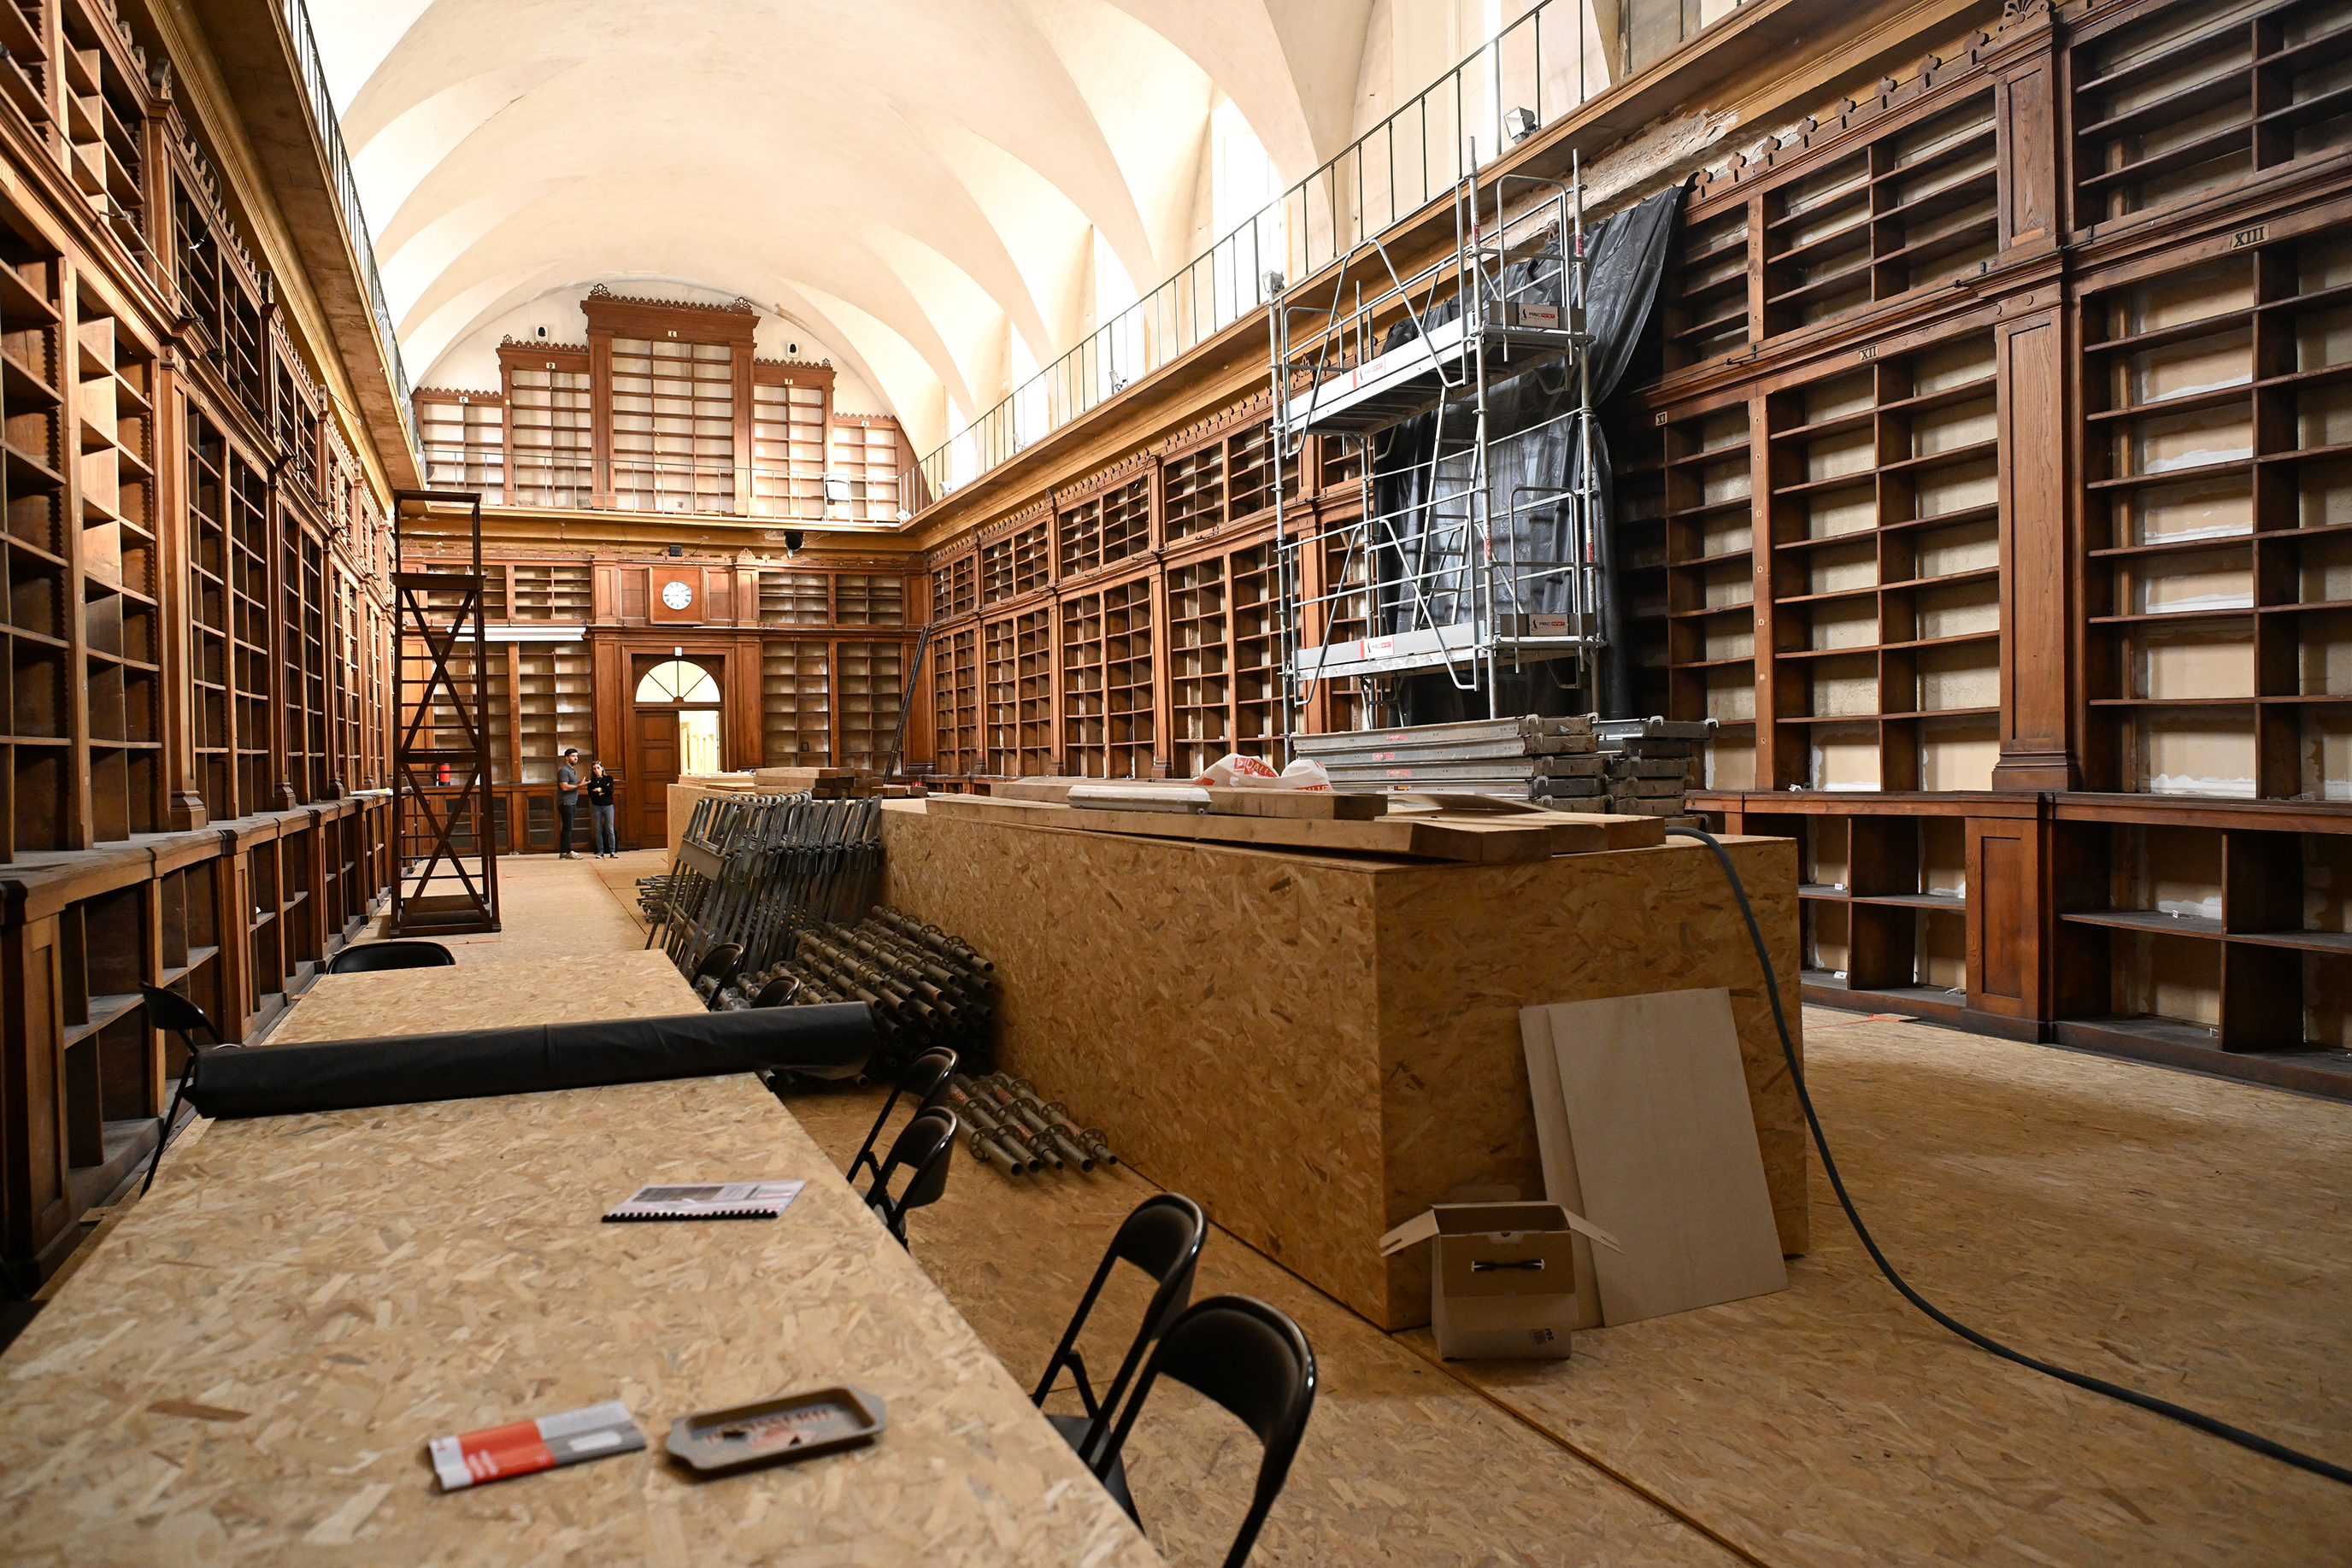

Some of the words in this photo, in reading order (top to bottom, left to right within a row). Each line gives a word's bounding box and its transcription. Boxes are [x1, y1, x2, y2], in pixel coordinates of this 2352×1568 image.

[2233, 226, 2265, 249] XIII
[1861, 345, 1877, 361] XII
[1657, 414, 1666, 424] XI
